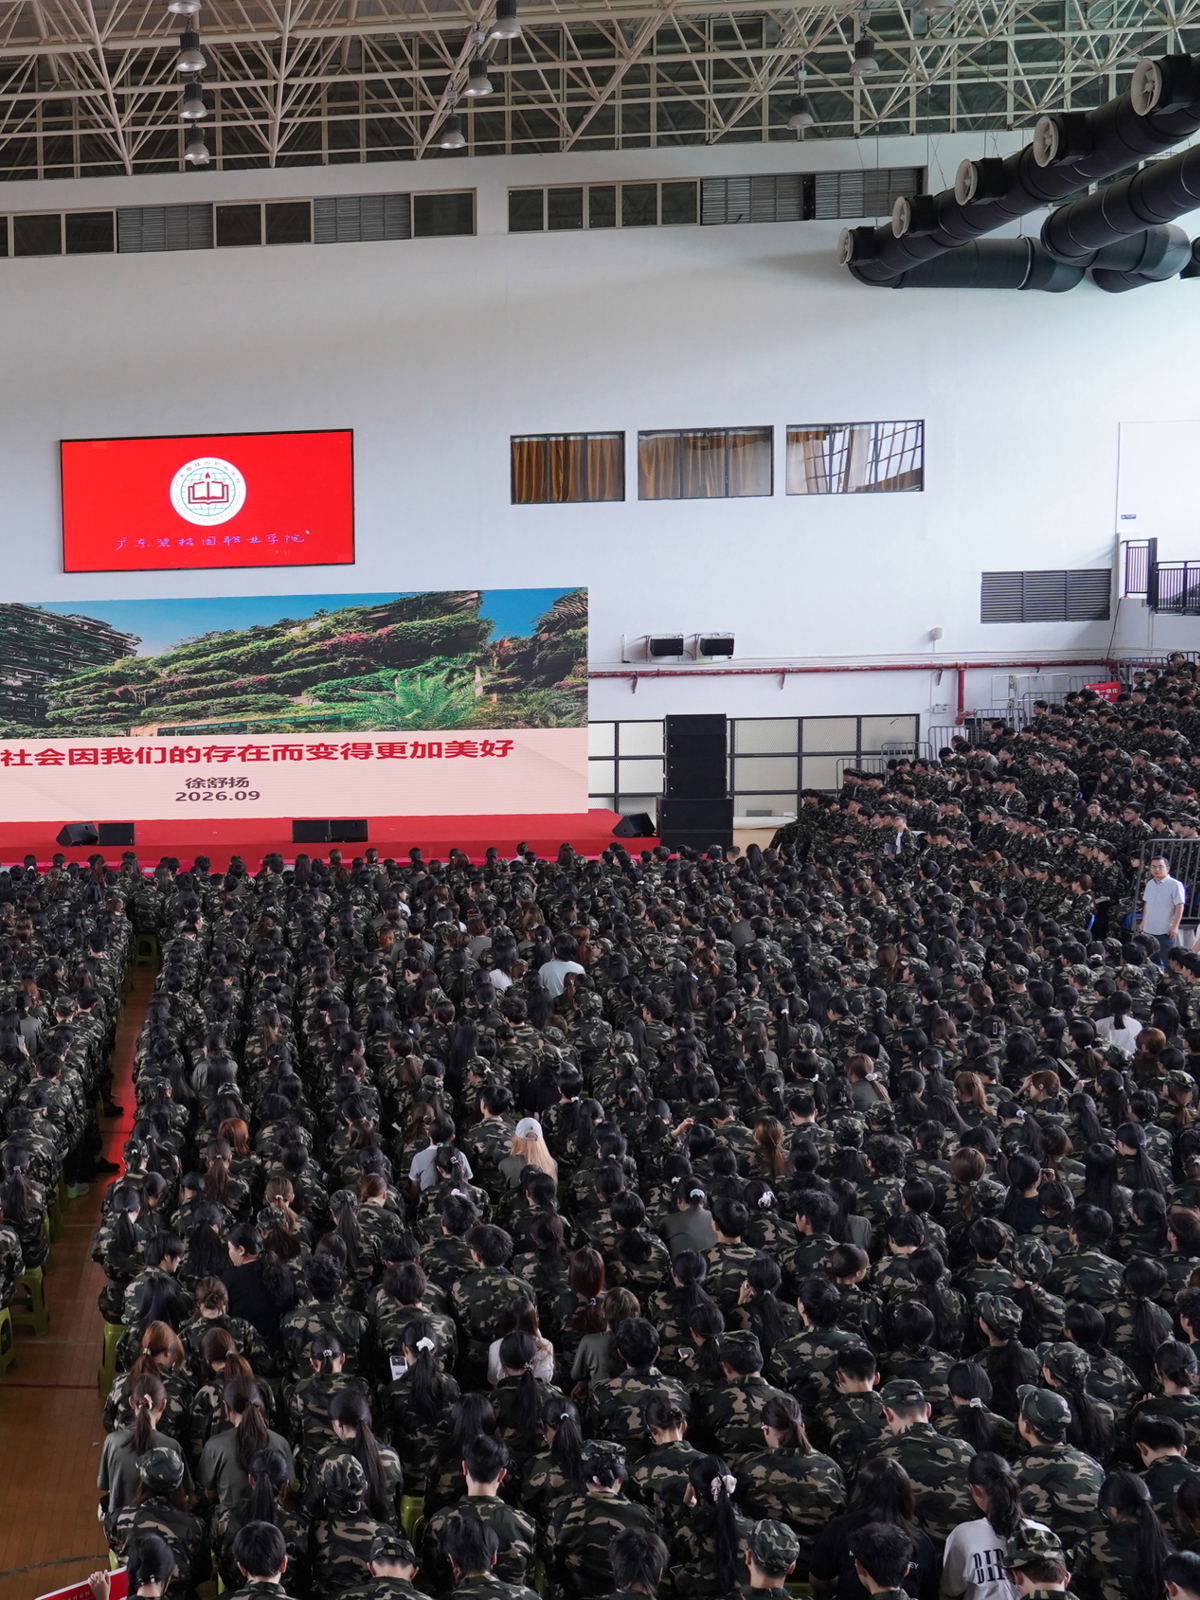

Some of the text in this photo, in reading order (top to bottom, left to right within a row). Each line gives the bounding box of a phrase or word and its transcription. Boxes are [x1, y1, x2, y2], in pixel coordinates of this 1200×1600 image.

[185, 776, 250, 789] 徐舒扬
[175, 790, 261, 802] 2026.09
